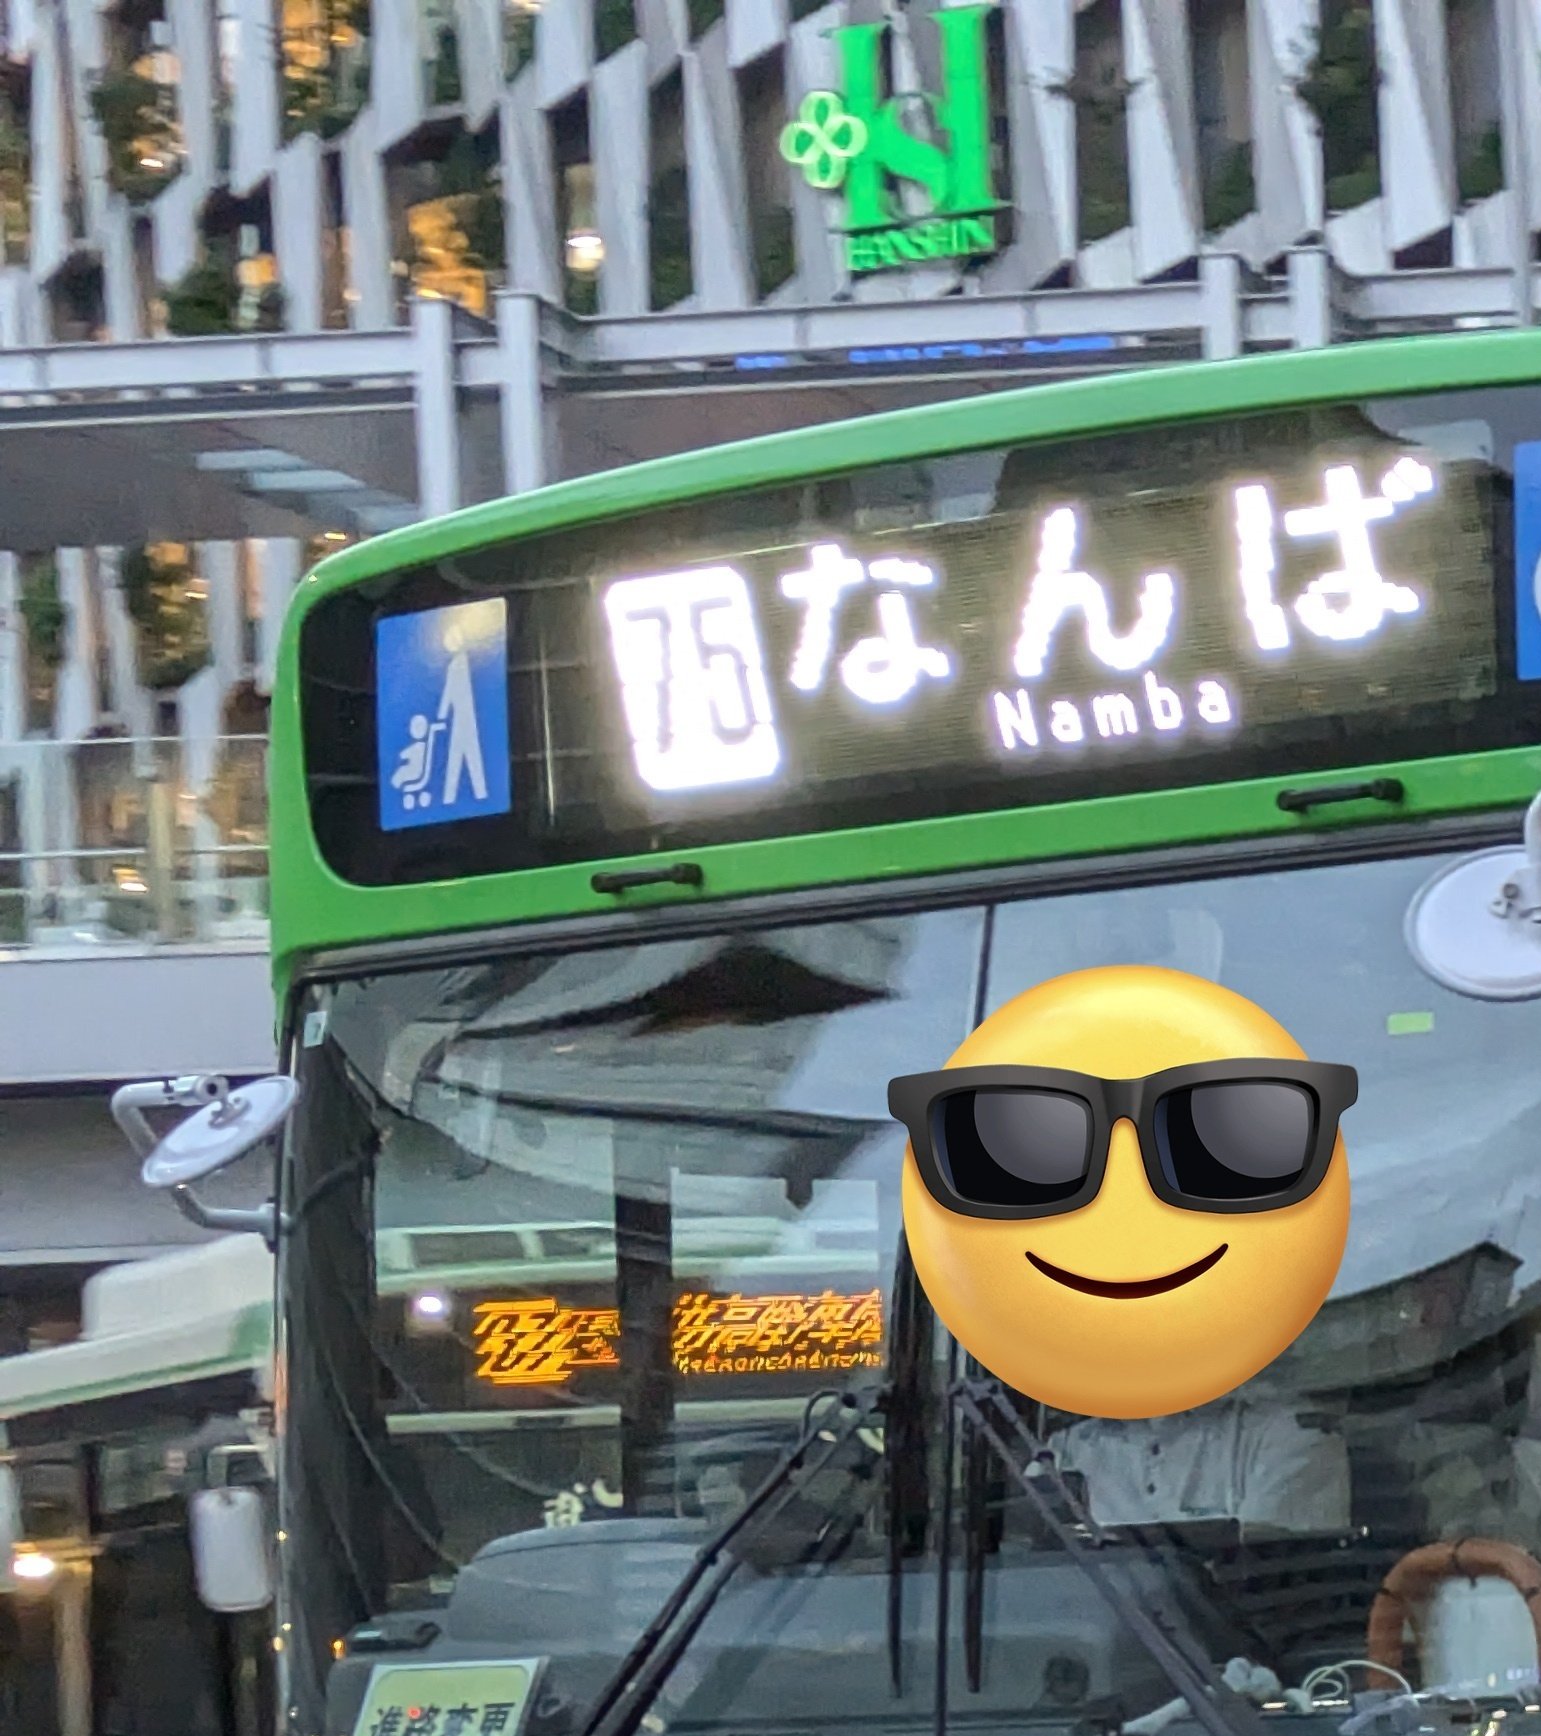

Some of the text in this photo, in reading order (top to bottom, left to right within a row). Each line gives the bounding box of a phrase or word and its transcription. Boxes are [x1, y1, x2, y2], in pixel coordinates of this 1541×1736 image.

[626, 456, 1434, 754] 75 なんば
[994, 676, 1233, 750] Namba
